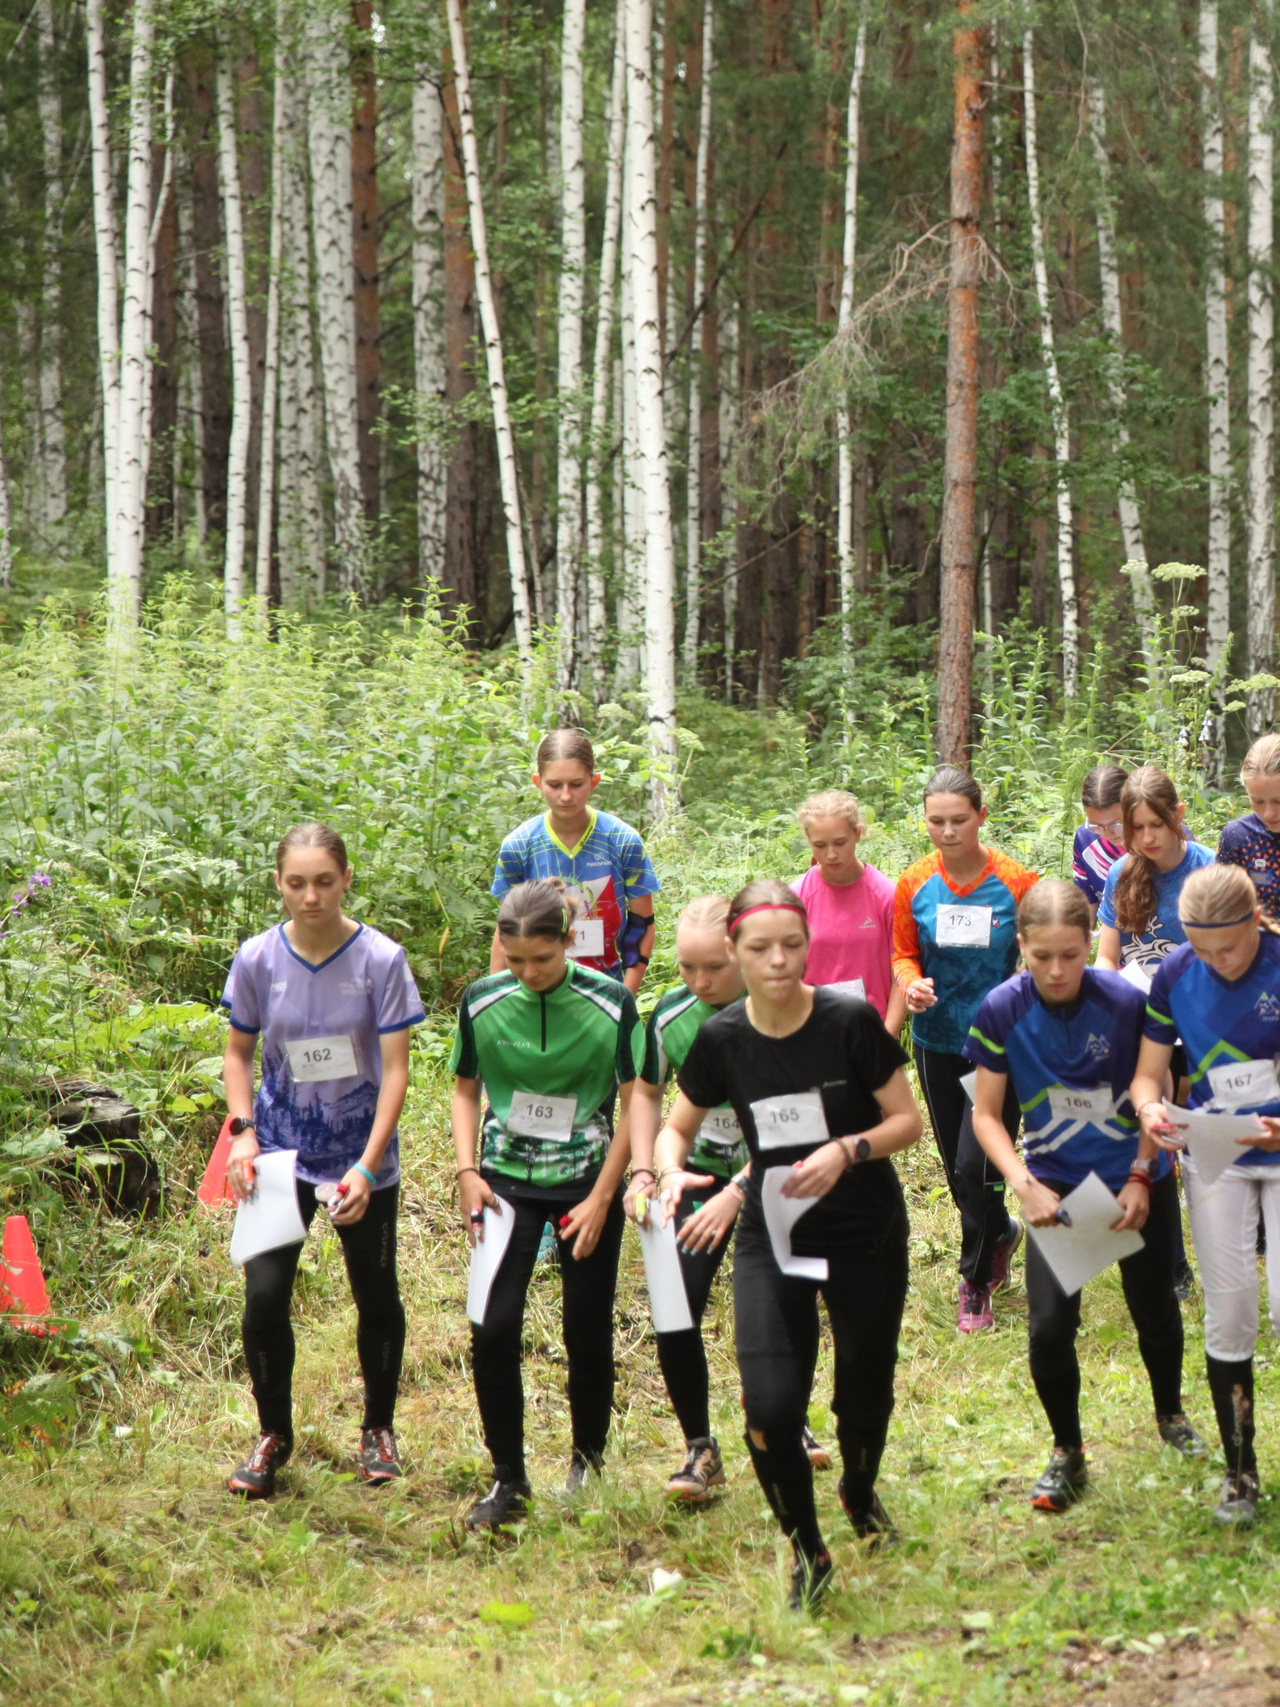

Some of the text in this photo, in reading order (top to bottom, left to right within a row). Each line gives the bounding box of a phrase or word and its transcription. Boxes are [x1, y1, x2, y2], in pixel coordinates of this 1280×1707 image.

[949, 914, 972, 927] 173
[303, 1047, 333, 1064] 162
[1225, 1073, 1252, 1090] 167
[1064, 1096, 1092, 1109] 166
[526, 1103, 554, 1119] 163
[770, 1107, 800, 1124] 165
[713, 1116, 741, 1130] 164
